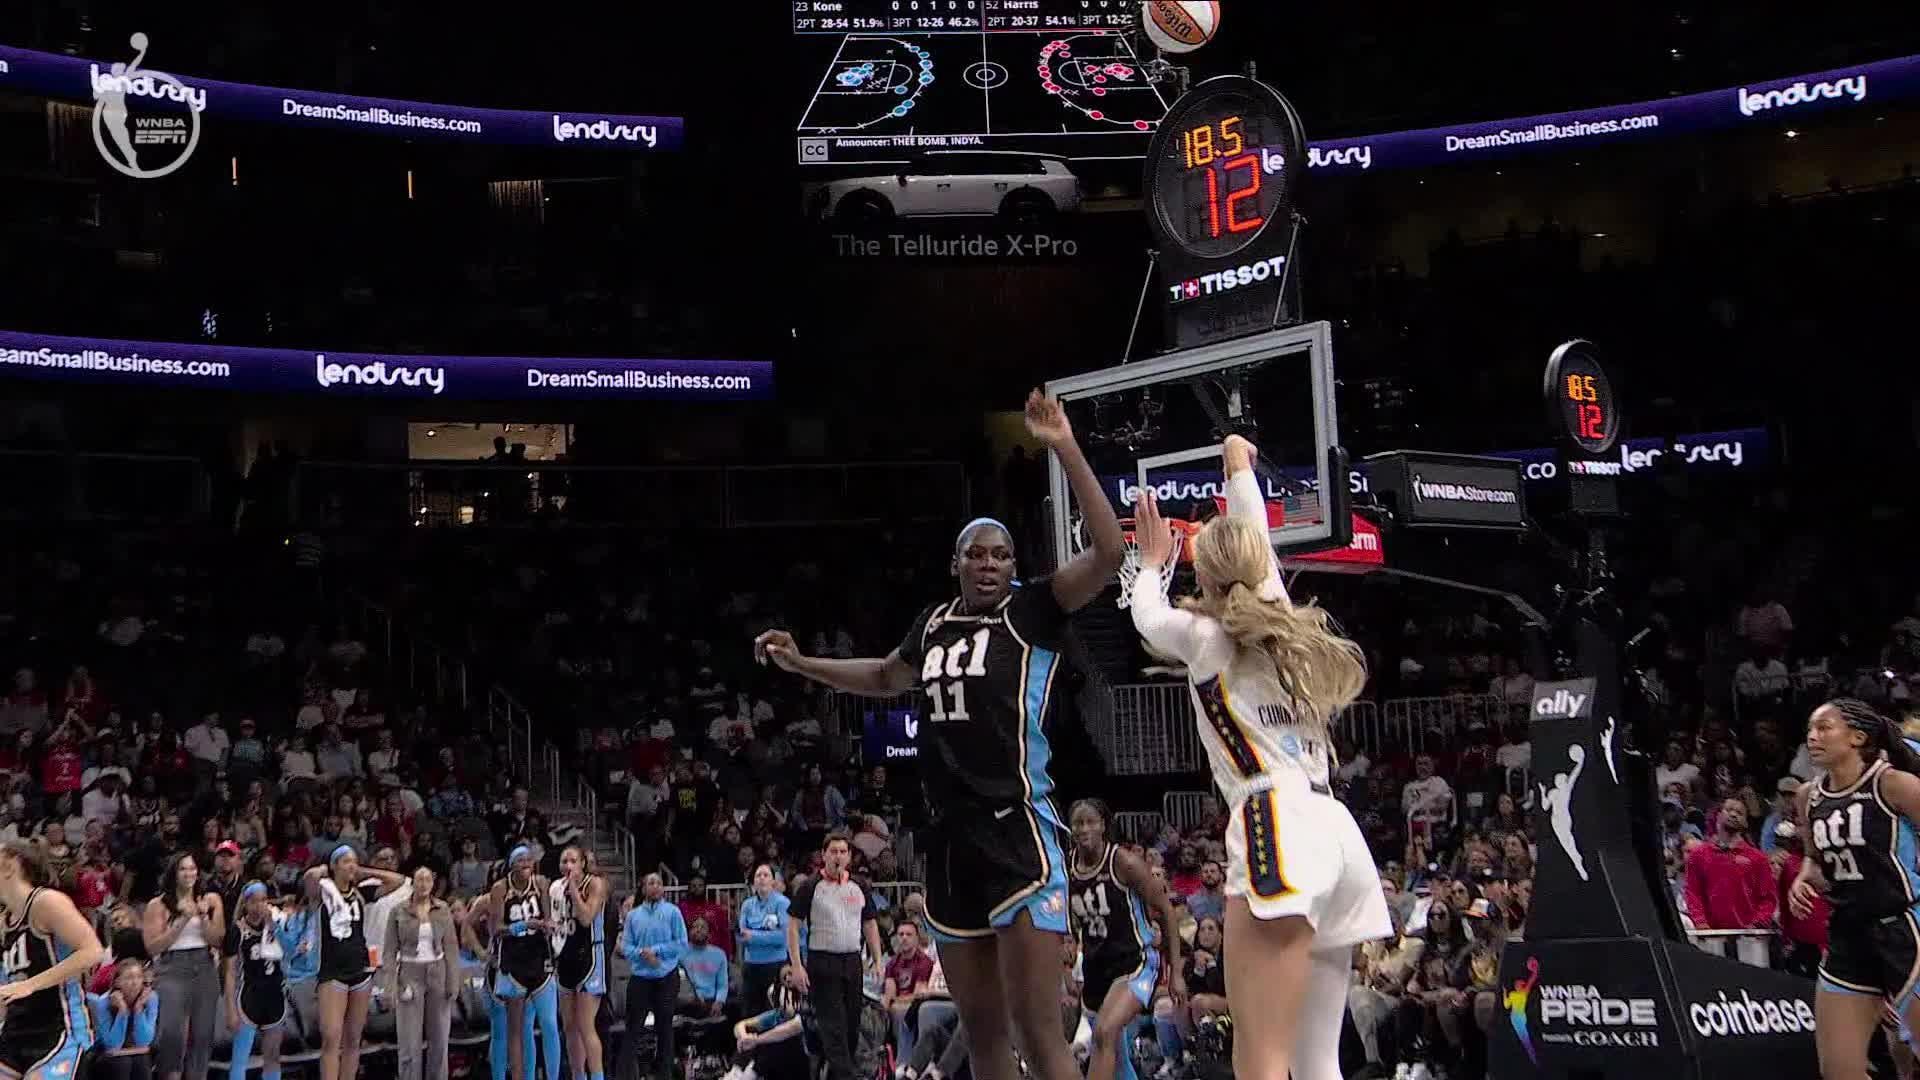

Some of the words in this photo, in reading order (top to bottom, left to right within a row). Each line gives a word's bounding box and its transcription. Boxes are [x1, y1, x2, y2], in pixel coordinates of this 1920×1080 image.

[795, 2, 808, 12] 23
[813, 2, 843, 12] Kone
[892, 1, 899, 10] 0
[911, 1, 918, 10] 0
[930, 1, 936, 10] 1
[949, 1, 956, 10] 0
[968, 1, 975, 10] 0
[1003, 0, 1039, 9] Harris
[797, 19, 816, 28] 2PT
[821, 18, 848, 28] 28-54
[853, 18, 884, 28] 51.9%
[892, 18, 911, 28] 3PT
[917, 17, 944, 27] 12-26
[948, 17, 979, 27] 46.2%
[987, 17, 1006, 26] 2PT
[1011, 16, 1039, 26] 20-37
[1045, 16, 1076, 26] 54.1%
[1082, 15, 1101, 25] 3PT
[1739, 75, 1866, 116] lendistry
[283, 98, 481, 133] DreamSmallBusiness.com
[553, 115, 657, 148] lendistry
[836, 138, 891, 147] Announcer:
[893, 137, 915, 147] THEE
[918, 136, 950, 147] BOMB,
[951, 136, 984, 146] INDYA.
[1184, 116, 1243, 169] 18.5
[1446, 114, 1658, 152] DreamSmallBusiness.com
[805, 145, 825, 156] CC
[1205, 154, 1264, 238] 12
[832, 234, 881, 256] The
[888, 234, 999, 256] Telluride
[1007, 234, 1078, 256] X-Pro
[1200, 256, 1285, 294] TISSOT
[0, 348, 230, 377] eamSmallBusiness.com
[316, 354, 444, 394] lendistry
[527, 369, 751, 390] DreamSmallBusiness.com
[1578, 404, 1606, 439] 12
[1582, 461, 1621, 475] TISSOT
[1420, 483, 1516, 503] WNBAStore.com
[926, 681, 970, 721] 11
[1536, 689, 1587, 718] ally
[1540, 985, 1601, 999] WNBA
[1541, 999, 1657, 1025] PRIDE
[1690, 988, 1817, 1037] coinbase
[1574, 1031, 1659, 1047] COACH
